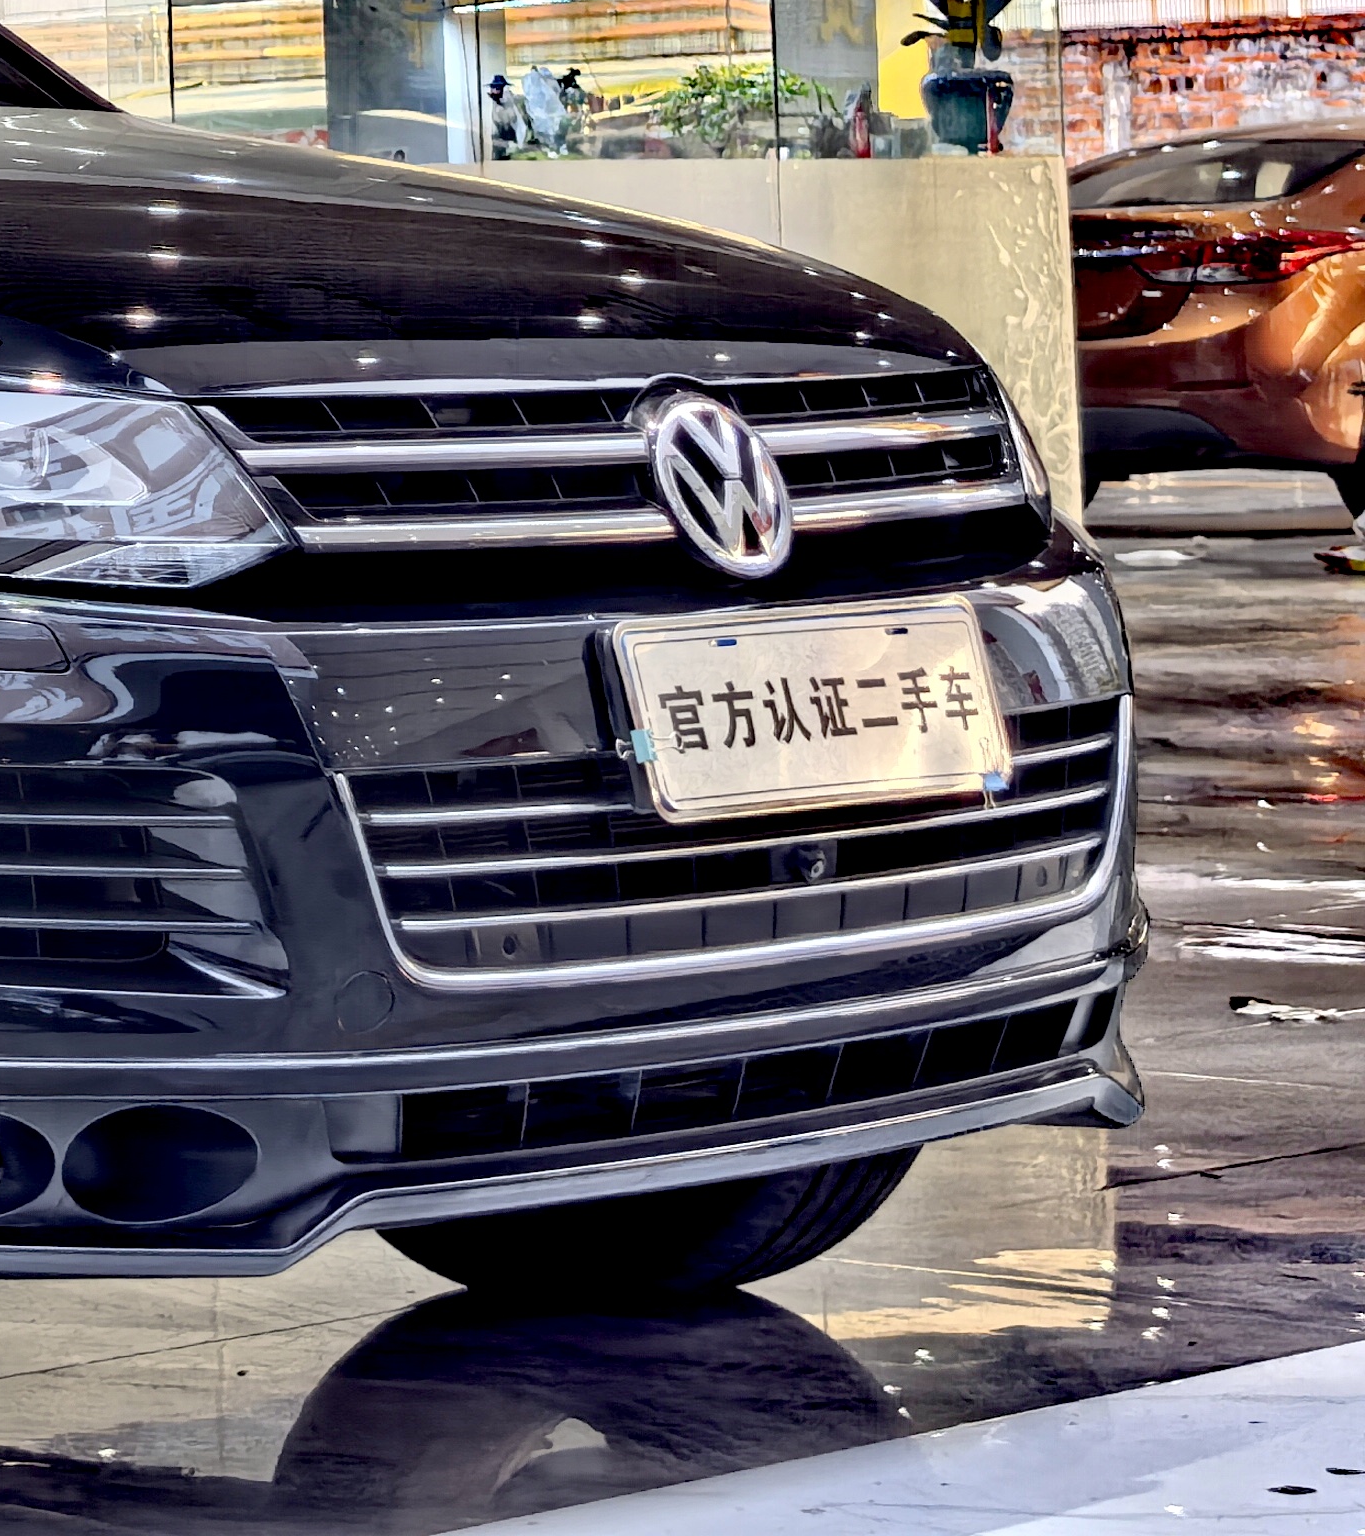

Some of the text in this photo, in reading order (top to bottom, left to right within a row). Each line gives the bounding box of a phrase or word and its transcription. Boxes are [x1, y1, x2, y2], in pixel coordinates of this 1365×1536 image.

[658, 666, 979, 754] 官方认证二手车
